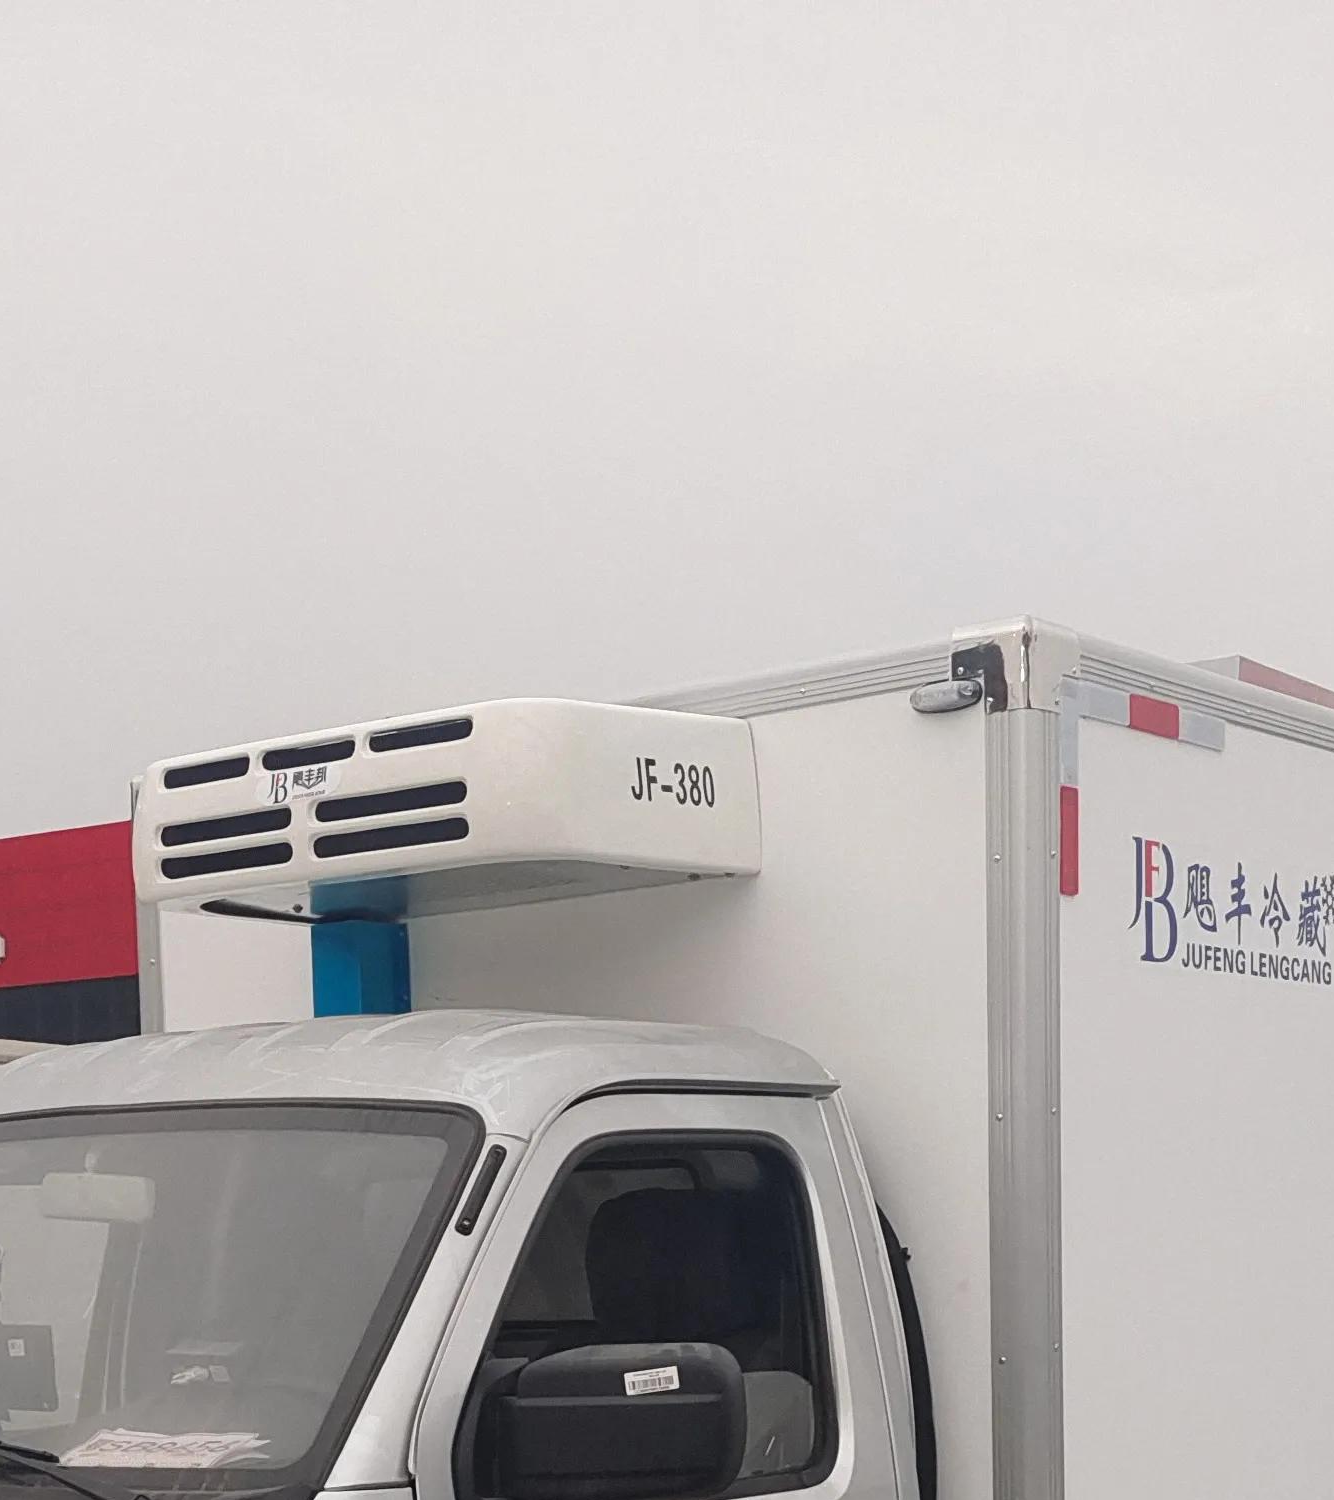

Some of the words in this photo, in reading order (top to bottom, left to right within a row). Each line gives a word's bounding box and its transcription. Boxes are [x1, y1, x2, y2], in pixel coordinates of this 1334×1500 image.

[630, 756, 716, 809] JF-380
[1181, 943, 1246, 975] JUFENG
[1250, 951, 1333, 985] LENGCANG
